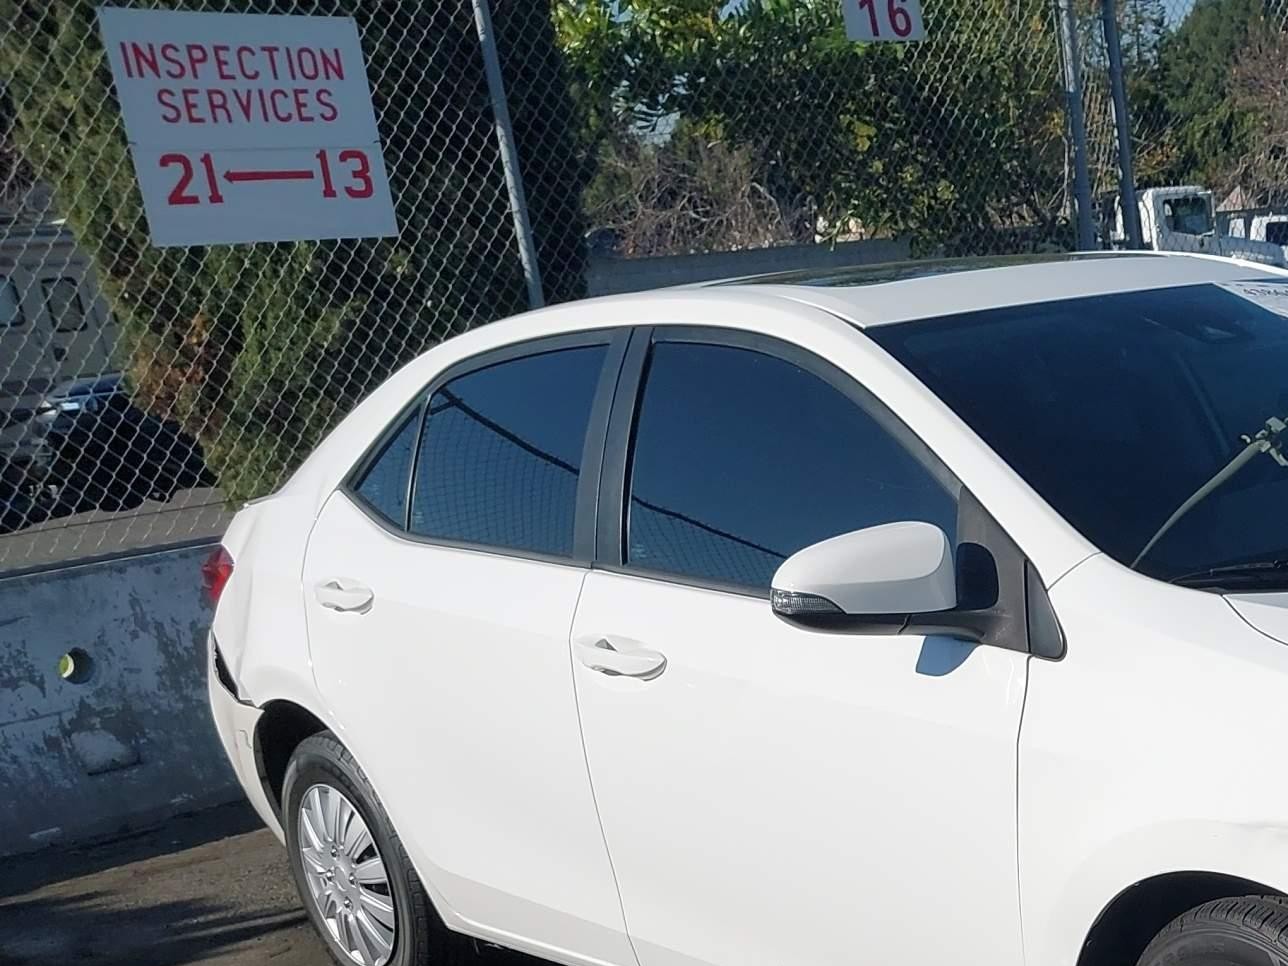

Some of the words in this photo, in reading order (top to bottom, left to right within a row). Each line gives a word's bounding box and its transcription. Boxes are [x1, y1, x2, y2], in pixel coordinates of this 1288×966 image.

[857, 0, 913, 38] 16
[119, 41, 345, 81] INSPECTION
[156, 88, 339, 124] SERVICES
[158, 152, 225, 206] 21
[315, 149, 375, 199] 13
